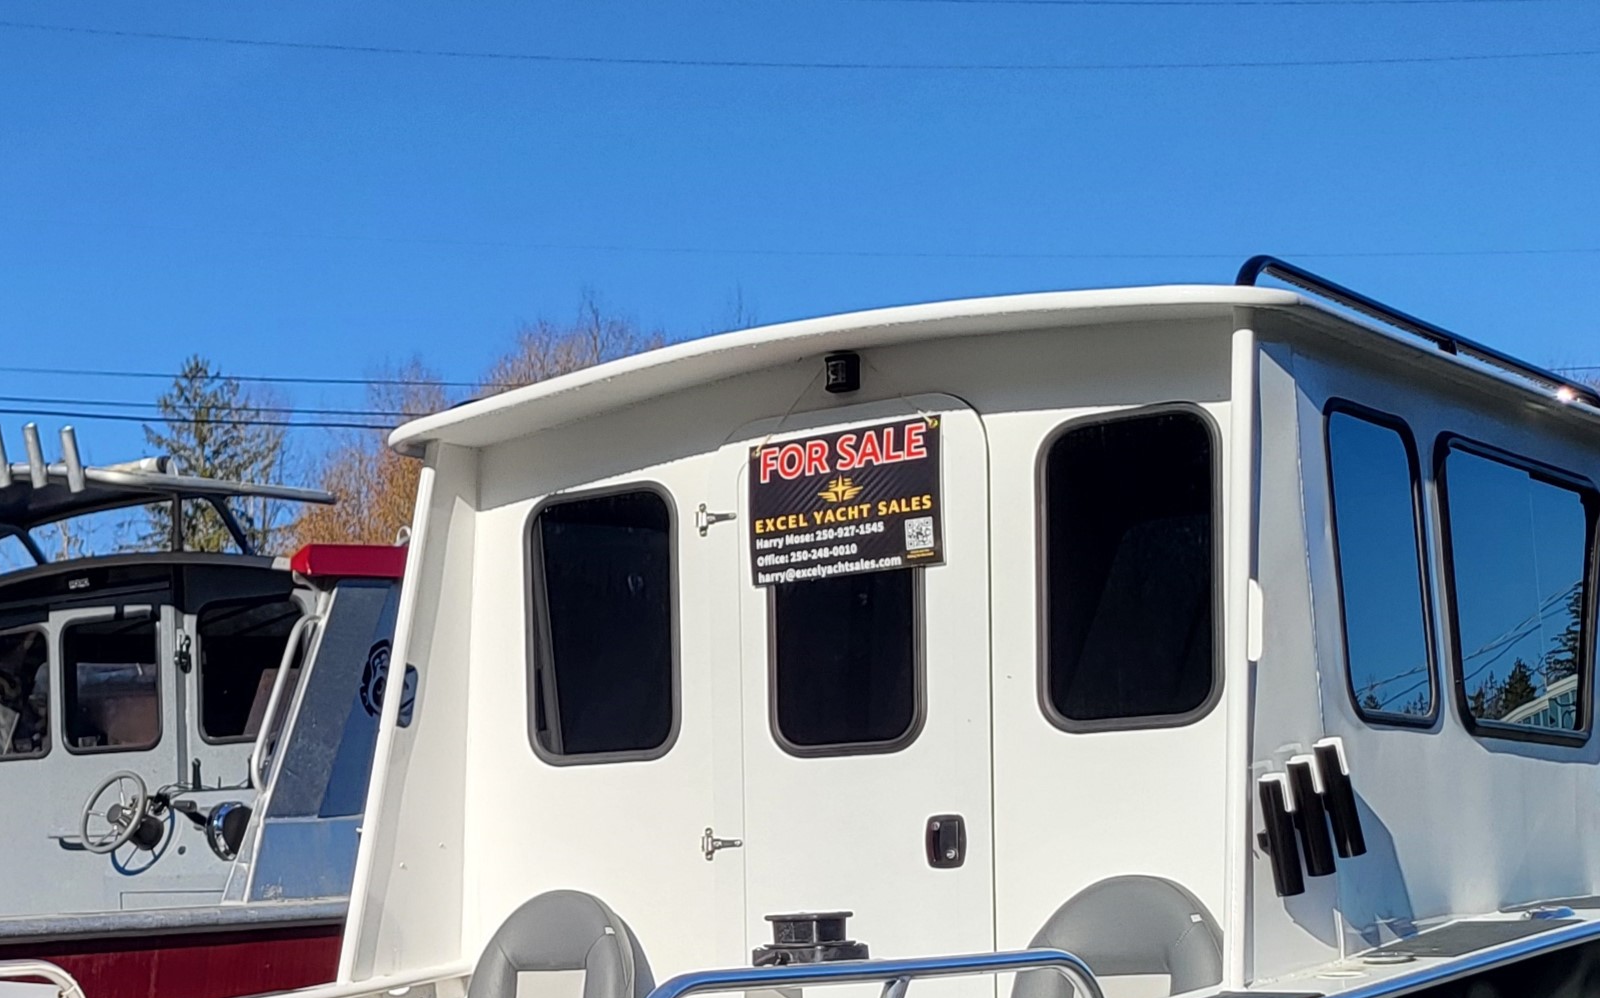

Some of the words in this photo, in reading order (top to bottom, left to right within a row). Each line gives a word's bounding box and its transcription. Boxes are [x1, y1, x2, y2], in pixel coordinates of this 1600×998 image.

[759, 439, 830, 484] FOR
[835, 421, 928, 471] SALE
[754, 513, 808, 534] EXCEL
[813, 503, 872, 526] YACHT
[877, 494, 933, 517] SALES
[755, 536, 784, 550] Harry
[815, 521, 885, 542] 250-927-1545
[756, 554, 790, 567] Office:
[790, 543, 859, 563] 250-248-0010
[757, 555, 903, 584] harry@excelyachtsales.com
